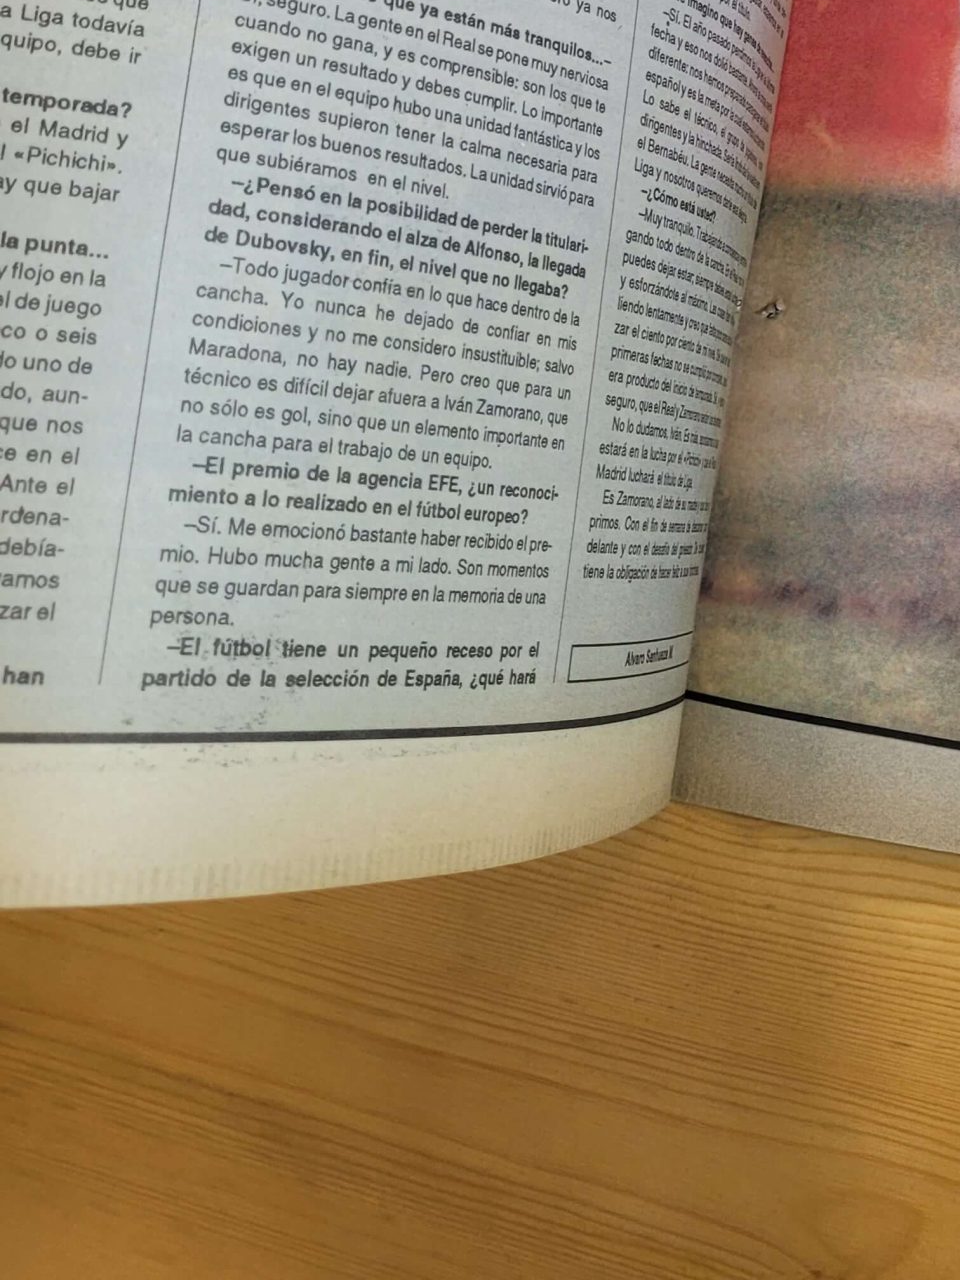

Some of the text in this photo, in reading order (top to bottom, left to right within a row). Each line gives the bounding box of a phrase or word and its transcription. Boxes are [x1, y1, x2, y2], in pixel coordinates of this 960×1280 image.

[419, 2, 439, 19] ya
[443, 9, 486, 31] están
[489, 21, 521, 41] más
[1, 87, 133, 119] temporada?
[319, 191, 343, 207] en
[347, 191, 363, 209] la
[365, 199, 459, 227] posibilidad
[459, 213, 479, 231] de
[481, 221, 529, 241] perder
[531, 227, 543, 245] la
[545, 231, 589, 255] titulari-
[203, 225, 569, 300] de Dubovsky, en fin, el nivel que no llegaba?
[0, 473, 75, 497] Ante el
[149, 609, 235, 629] persona.
[213, 637, 271, 661] fútbol
[279, 640, 327, 659] tiene
[337, 643, 359, 659] un
[367, 640, 438, 663] pequeño
[445, 645, 493, 659] receso
[499, 645, 523, 663] por
[528, 640, 541, 659] el
[1, 665, 45, 686] han
[140, 667, 217, 692] partido
[225, 668, 251, 688] de
[259, 669, 277, 688] la
[285, 669, 370, 688] selección
[377, 669, 398, 687] de
[403, 669, 463, 692] España,
[508, 667, 537, 685] hará
